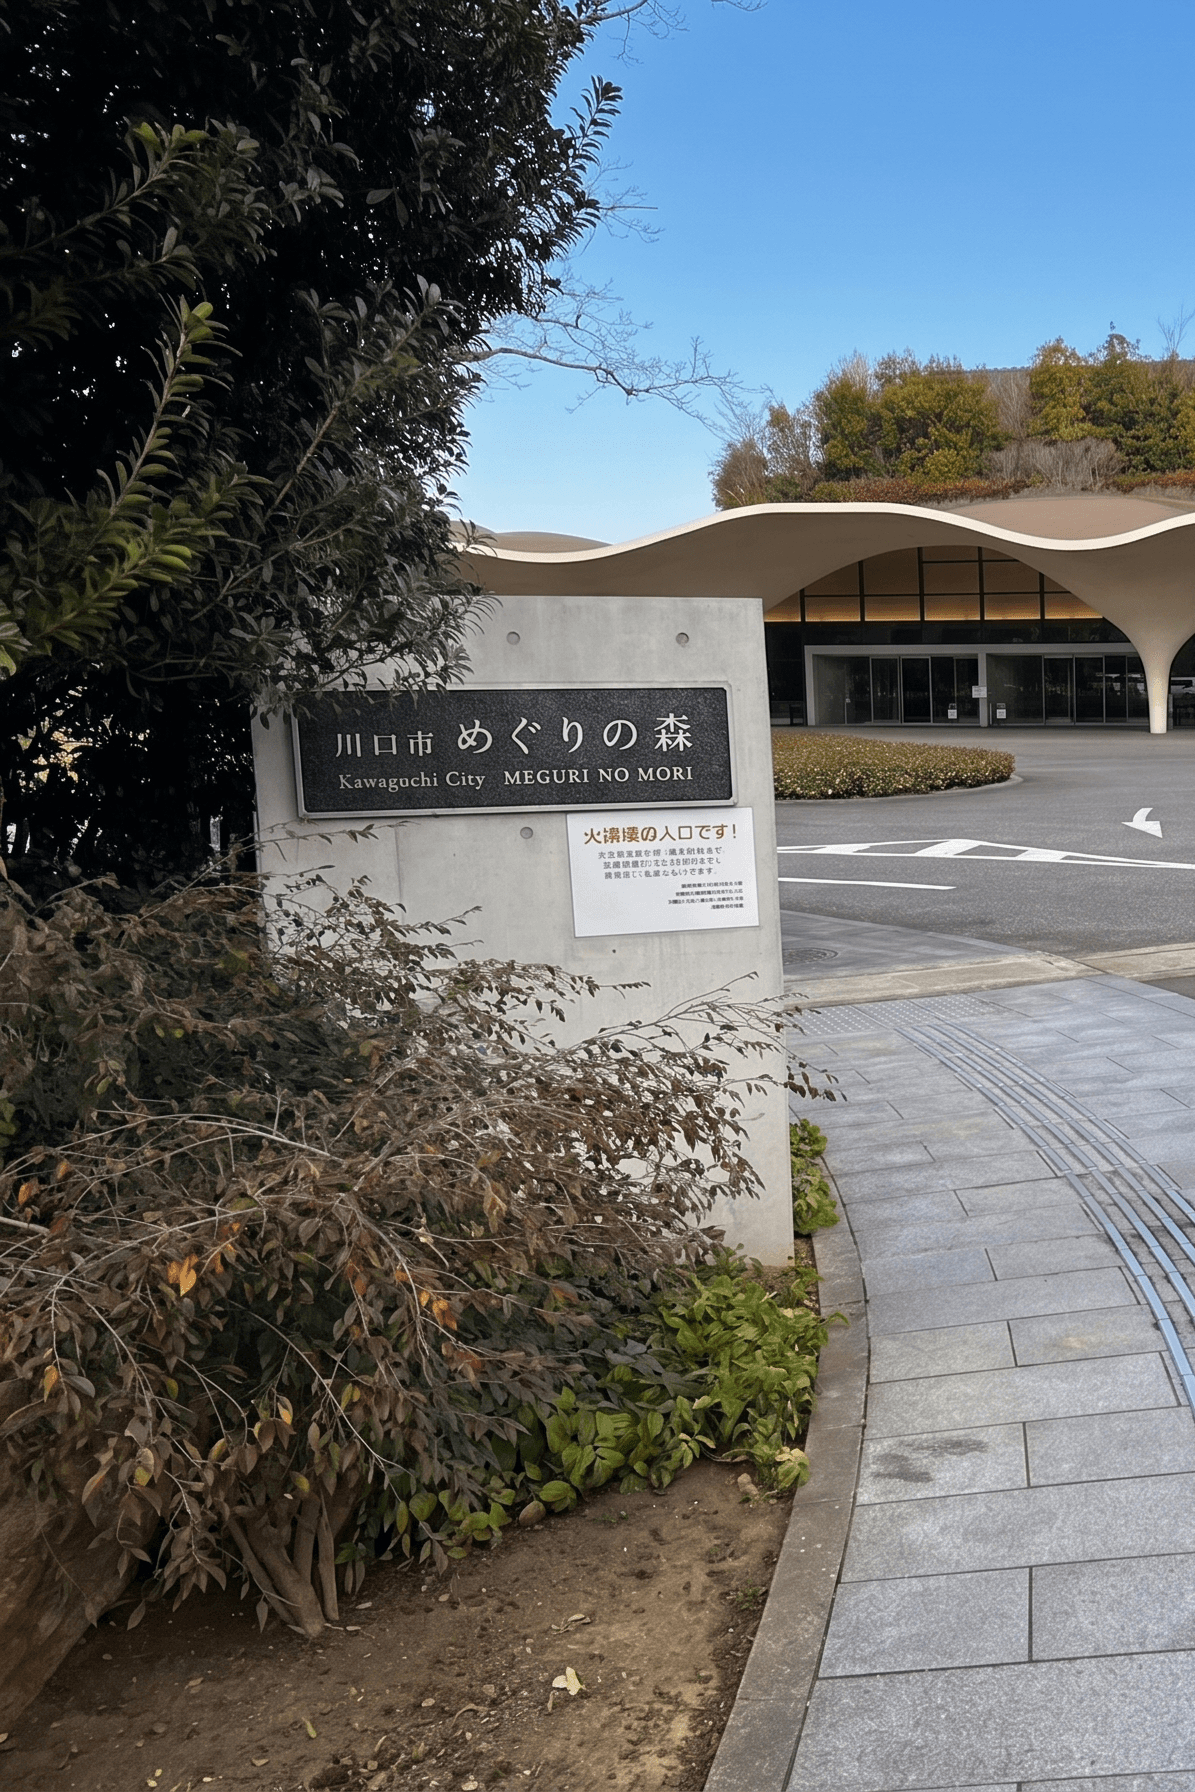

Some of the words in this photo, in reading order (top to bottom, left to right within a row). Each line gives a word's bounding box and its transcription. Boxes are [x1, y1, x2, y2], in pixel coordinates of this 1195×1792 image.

[335, 730, 434, 758] 川口市
[457, 712, 693, 755] めぐりの森
[338, 771, 439, 793] Kawaguchi
[445, 771, 486, 790] City
[503, 768, 590, 785] MEGURI
[598, 767, 630, 783] NO
[637, 766, 694, 782] MORI
